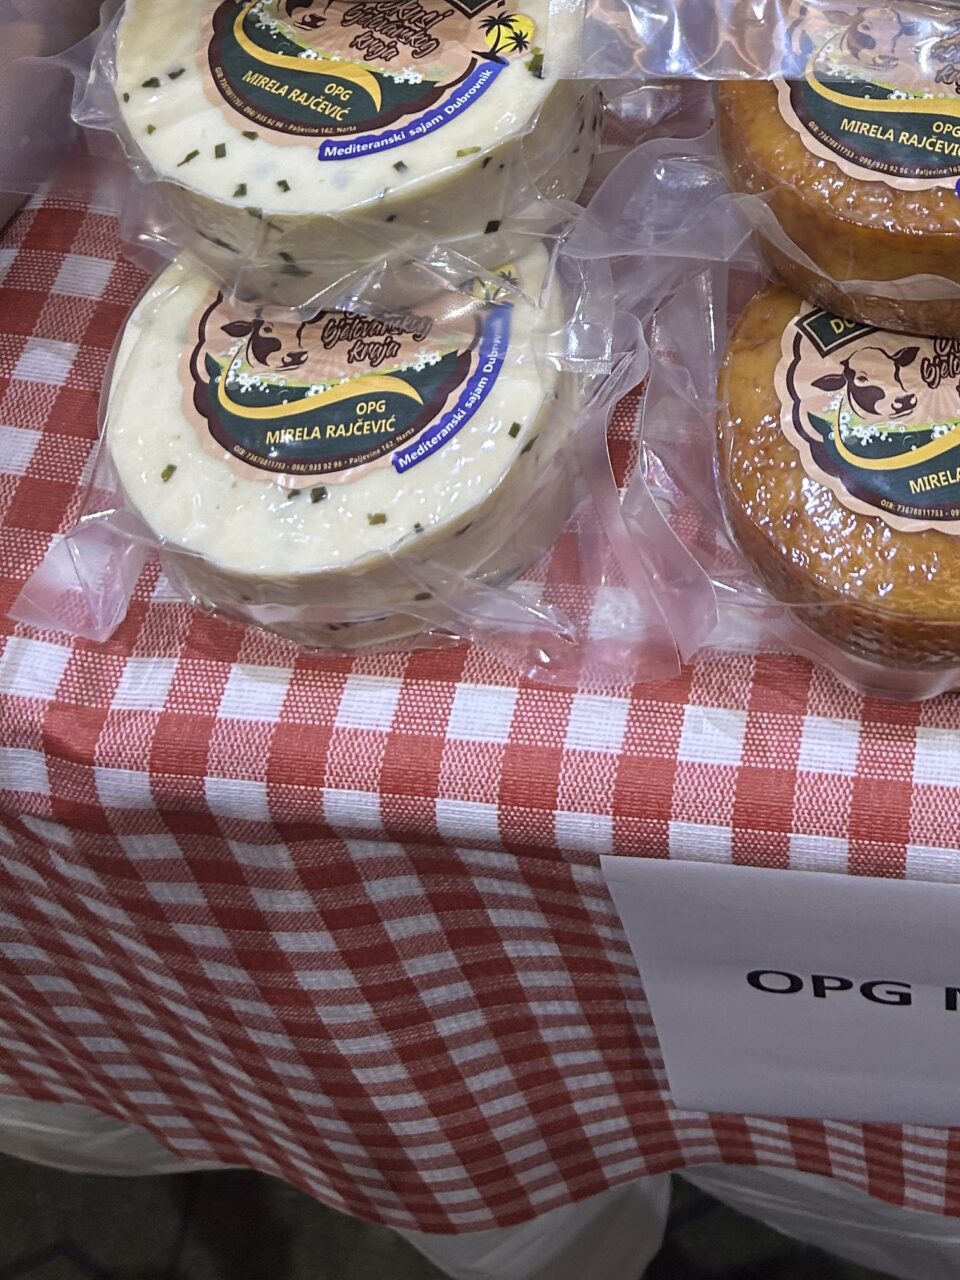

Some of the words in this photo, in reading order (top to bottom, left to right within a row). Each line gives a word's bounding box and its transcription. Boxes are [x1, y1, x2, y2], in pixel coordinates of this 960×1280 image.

[241, 70, 289, 97] MIRELA
[288, 87, 352, 122] RAJČEVIĆ
[324, 83, 353, 101] OPG
[324, 131, 406, 158] Mediteranski
[408, 112, 444, 138] sajam
[444, 69, 494, 116] Dubrovnik
[840, 118, 894, 142] MIRELA
[347, 336, 401, 367] kraja
[356, 400, 386, 416] OPG
[398, 408, 466, 468] Mediteranski
[465, 376, 489, 408] sajam
[265, 426, 321, 445] MIRELA
[326, 414, 396, 438] RAJČEVIĆ
[746, 969, 913, 1006] OPG
